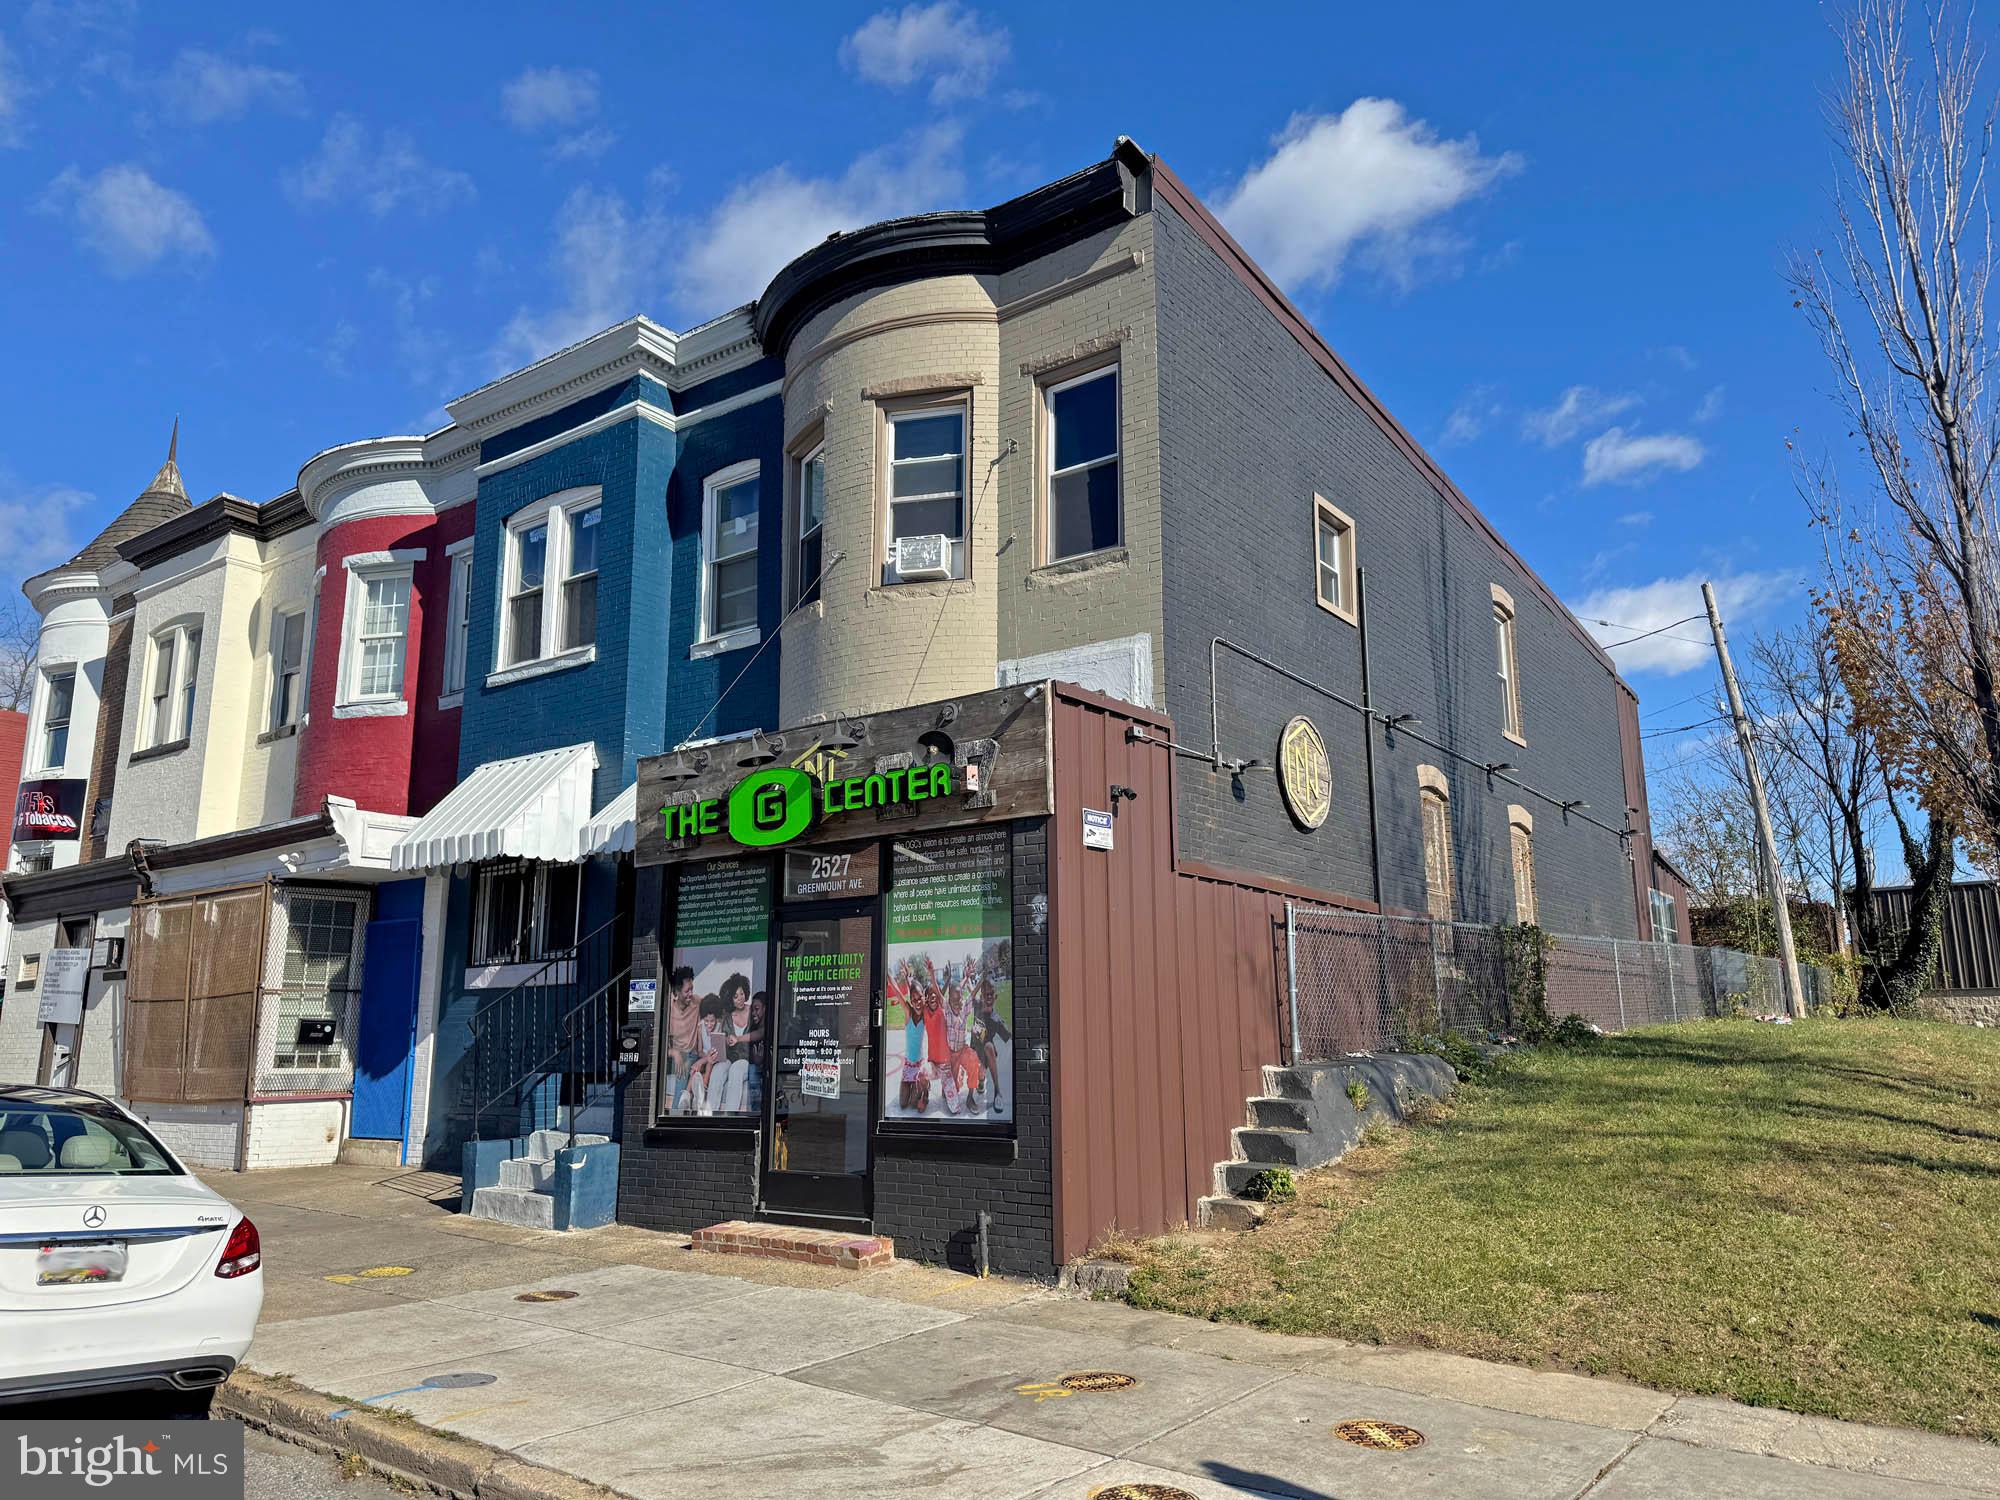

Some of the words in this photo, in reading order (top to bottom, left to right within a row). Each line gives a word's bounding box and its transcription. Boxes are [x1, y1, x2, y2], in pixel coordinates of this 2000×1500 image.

[660, 799, 719, 840] THE
[825, 763, 951, 813] CENTER
[25, 812, 77, 828] Tobacco
[923, 839, 938, 848] vision
[950, 836, 966, 844] create
[976, 831, 1007, 841] atmosphere
[946, 848, 955, 856] feel
[994, 842, 1004, 851] and
[707, 863, 716, 871] Our
[717, 861, 739, 870] Services
[812, 854, 851, 879] 2527
[894, 865, 917, 875] motivated
[924, 862, 944, 872] address
[946, 861, 956, 870] their
[958, 859, 974, 868] mental
[977, 857, 992, 866] health
[994, 856, 1004, 865] and
[894, 877, 918, 887] substance
[954, 872, 971, 881] create
[977, 868, 1005, 879] community
[797, 880, 846, 894] GREENMOUNT
[849, 878, 865, 889] AVE.
[893, 890, 908, 898] where
[916, 887, 933, 899] people
[934, 886, 946, 895] have
[948, 884, 970, 893] unlimited
[971, 882, 992, 891] access
[992, 882, 997, 890] to
[893, 902, 917, 913] behavioral
[919, 901, 933, 909] health
[935, 899, 959, 908] resources
[961, 897, 979, 906] needed
[893, 915, 901, 923] not
[784, 956, 801, 968] THE
[803, 953, 865, 966] OPPORTUNITY
[787, 970, 824, 982] GROWTH
[827, 968, 860, 980] CENTER
[823, 1039, 839, 1047] Friday
